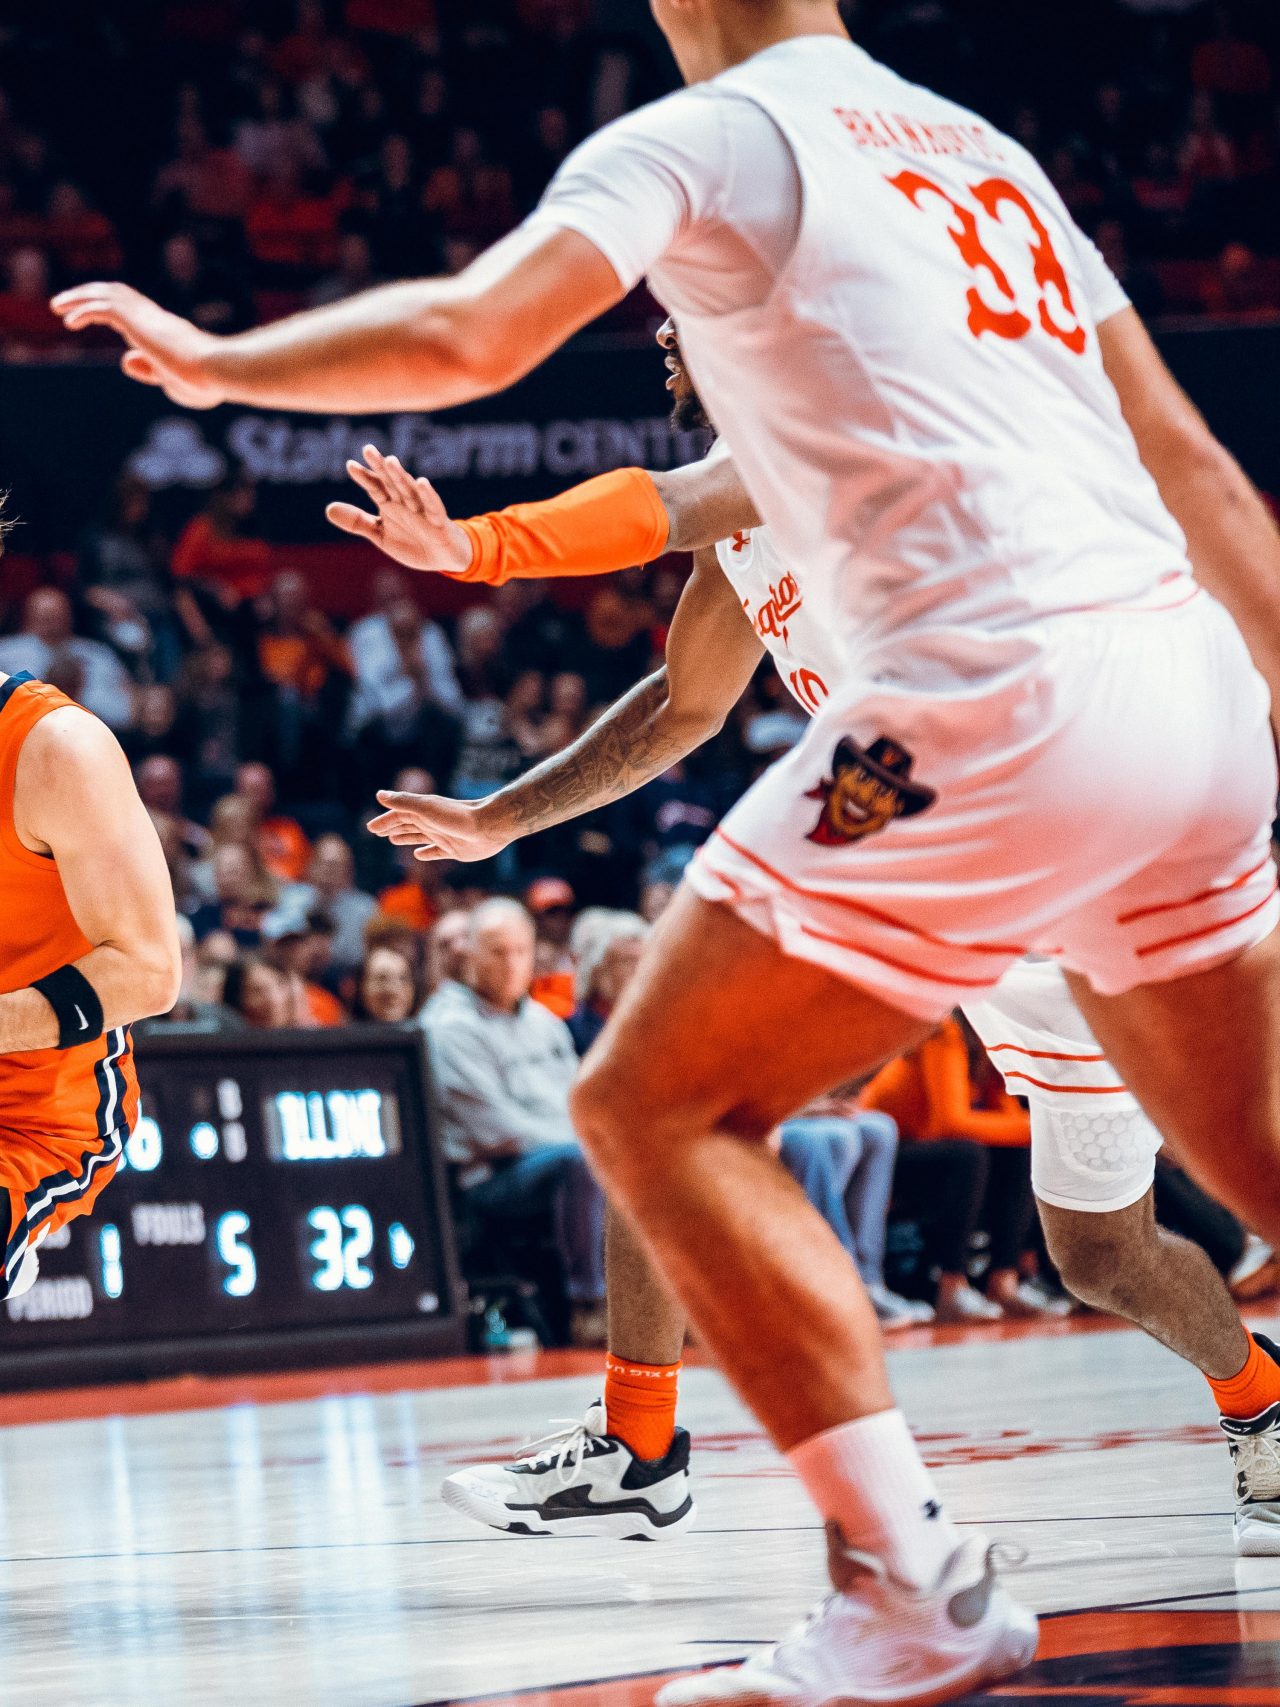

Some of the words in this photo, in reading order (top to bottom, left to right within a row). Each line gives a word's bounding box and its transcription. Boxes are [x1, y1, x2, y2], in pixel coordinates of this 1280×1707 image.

[881, 169, 1087, 356] 33
[228, 416, 386, 482] State
[389, 413, 538, 479] Farm
[216, 1210, 257, 1297] 5
[306, 1203, 375, 1291] 32
